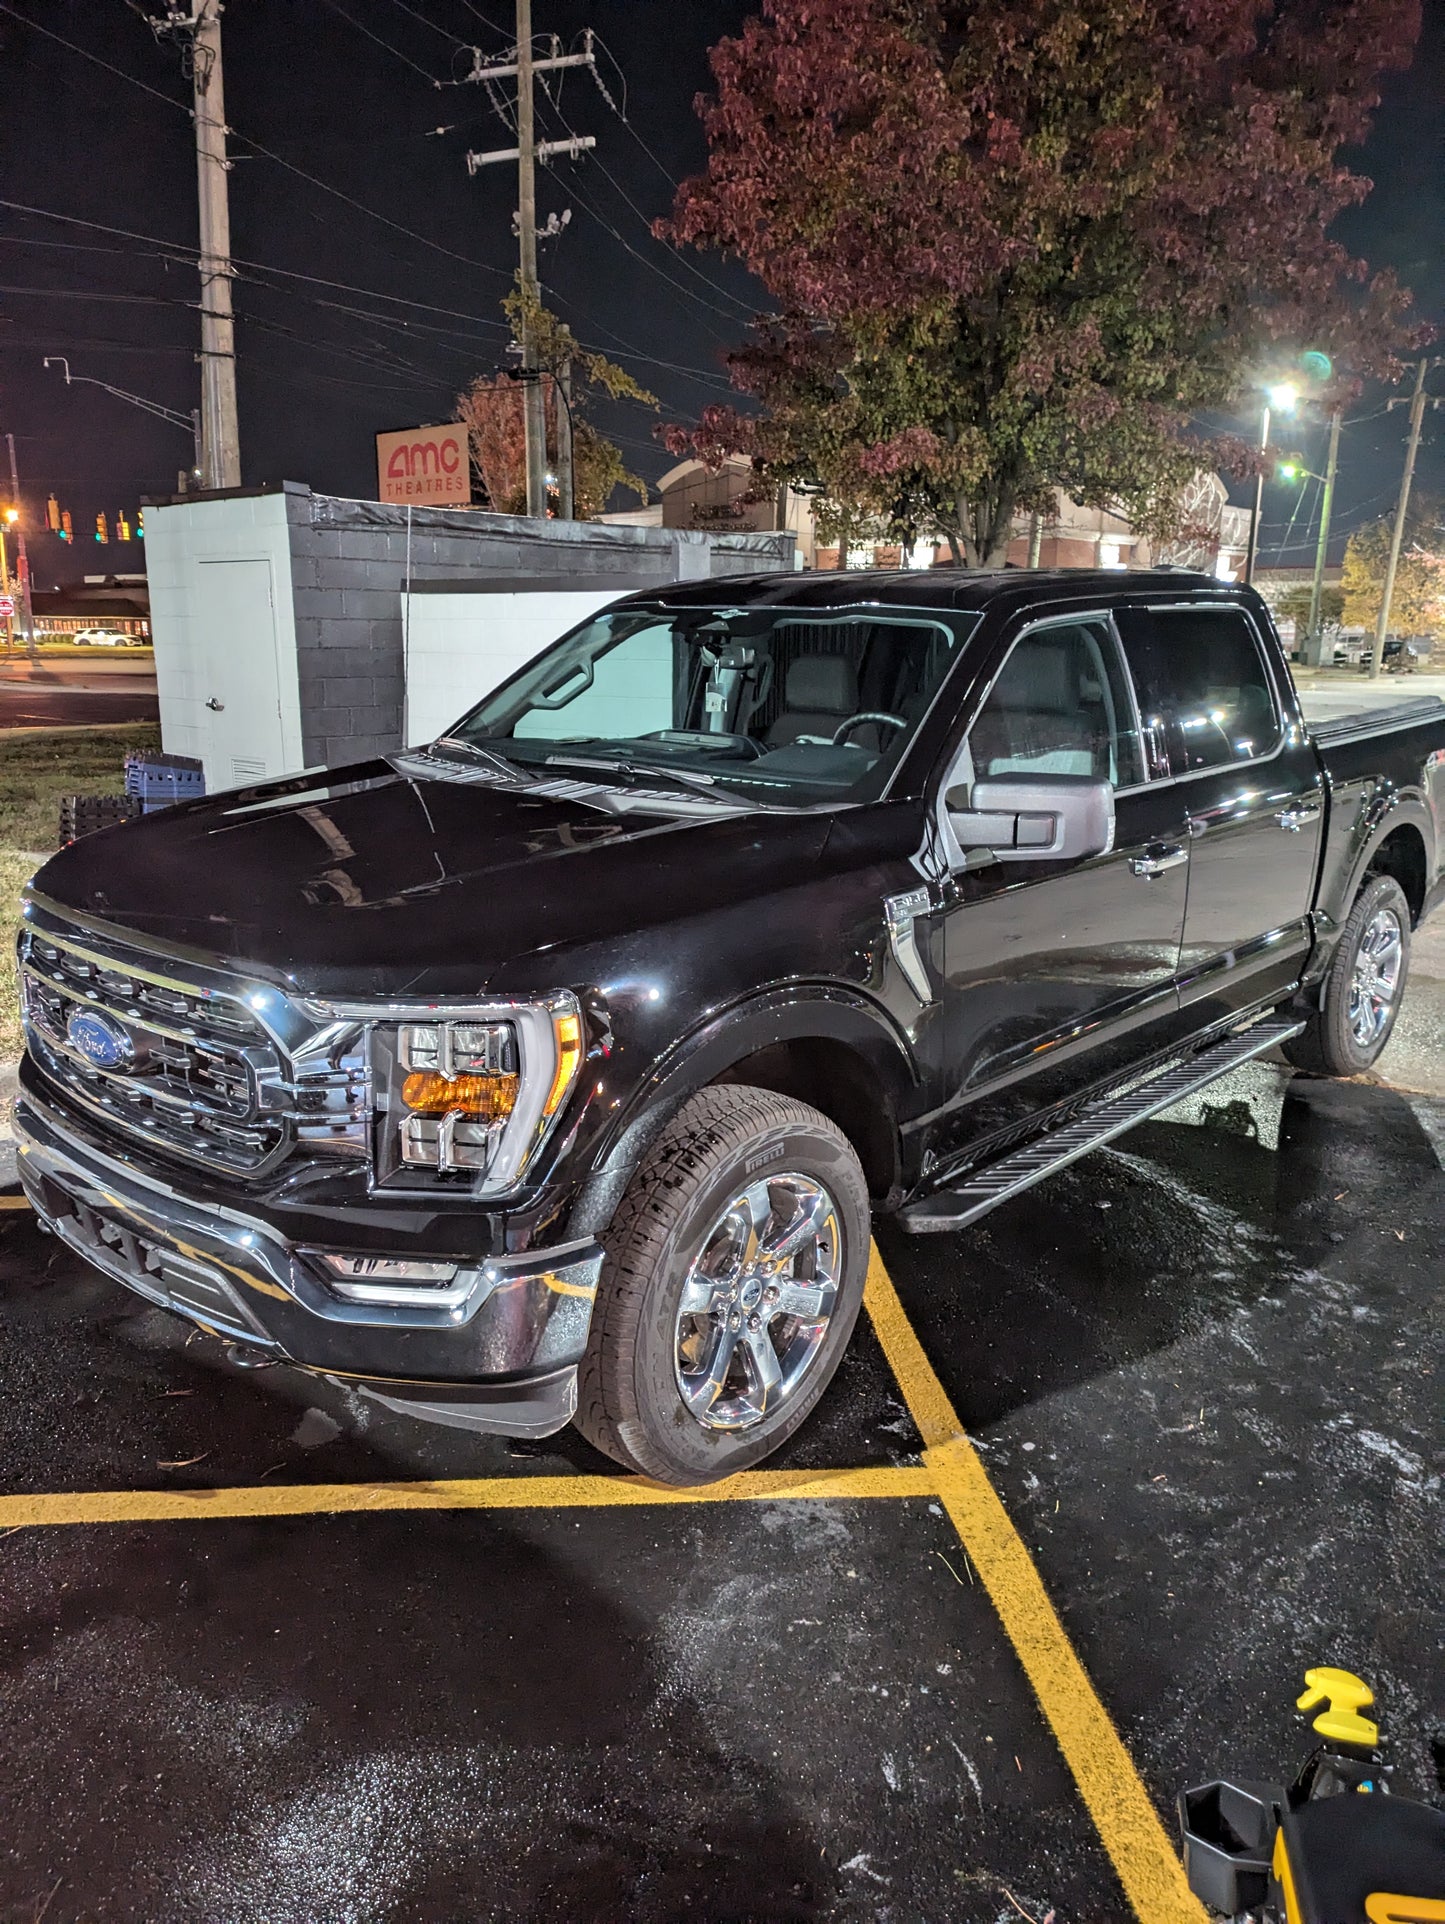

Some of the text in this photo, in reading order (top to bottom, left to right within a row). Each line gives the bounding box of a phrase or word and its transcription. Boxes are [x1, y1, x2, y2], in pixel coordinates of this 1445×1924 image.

[386, 477, 463, 496] THEATRES
[77, 1025, 107, 1057] Ford
[745, 1142, 784, 1174] PIRELLI
